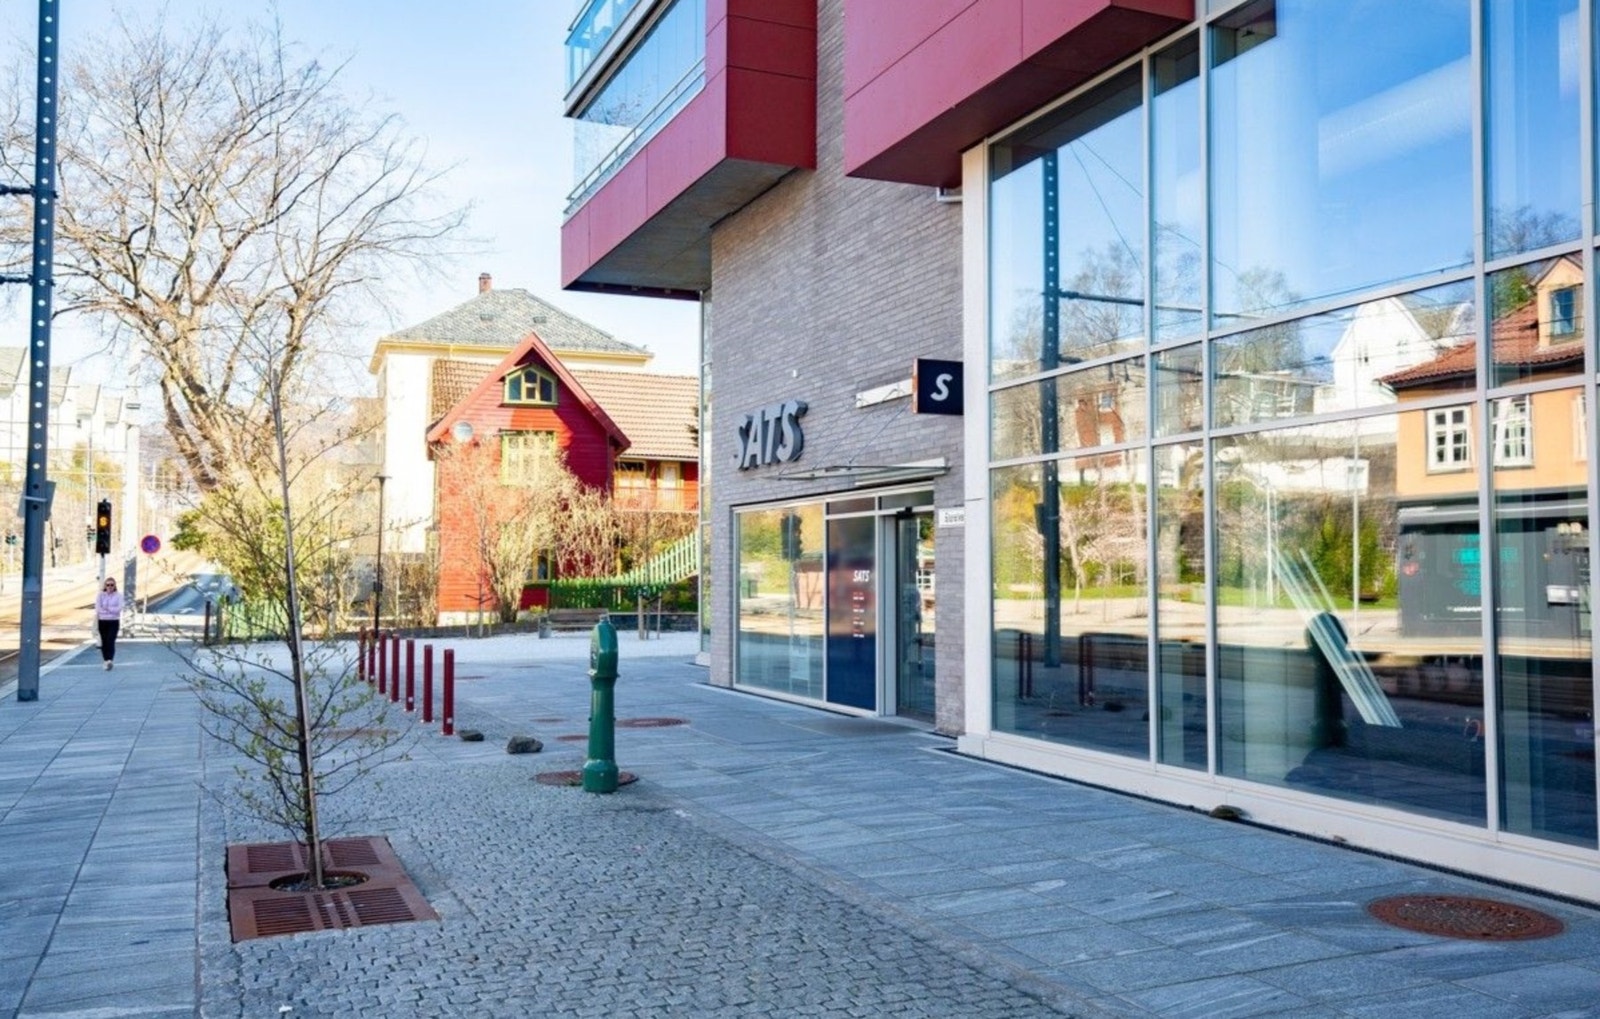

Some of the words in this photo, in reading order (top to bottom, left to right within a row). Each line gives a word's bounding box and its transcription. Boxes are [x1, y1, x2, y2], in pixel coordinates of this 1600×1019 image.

[930, 373, 953, 401] S
[734, 399, 808, 470] SATS
[853, 570, 870, 582] SATS
